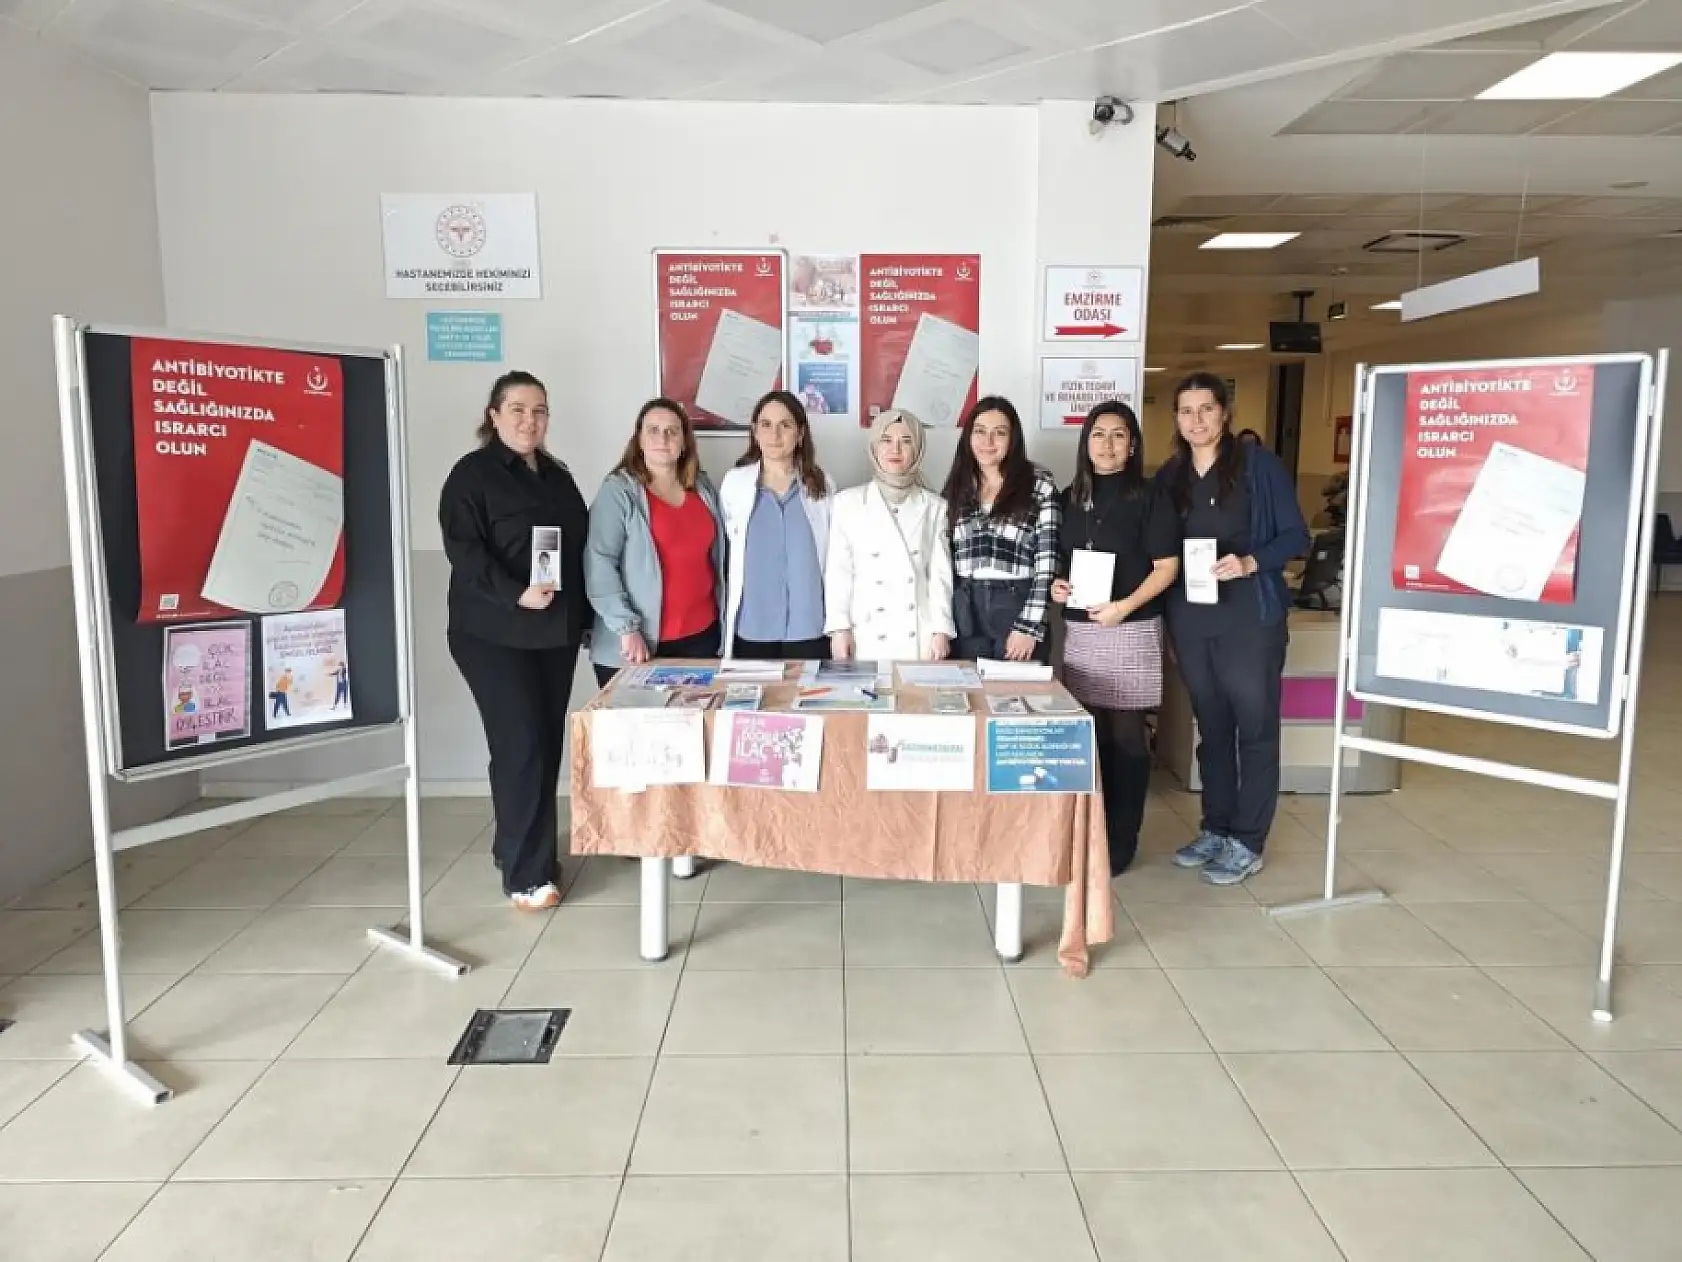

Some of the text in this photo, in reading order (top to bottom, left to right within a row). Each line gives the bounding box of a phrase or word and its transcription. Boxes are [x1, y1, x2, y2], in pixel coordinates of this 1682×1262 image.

[1064, 291, 1122, 307] EMZİRME
[1073, 308, 1111, 321] ODASI
[152, 359, 285, 384] ANTİBİYOTİKTE
[153, 379, 208, 396] DEĞİL
[1420, 378, 1532, 394] ANTİBİYOTİKTE
[153, 399, 275, 422] SAĞLIĞINIZDA
[1419, 398, 1461, 411] DEĞİL
[1419, 411, 1518, 426] SAĞLIĞINIZDA
[155, 420, 227, 437] ISRARCI
[1418, 431, 1475, 443] ISRARCI
[156, 440, 207, 456] OLUN
[1416, 446, 1457, 458] OLUN
